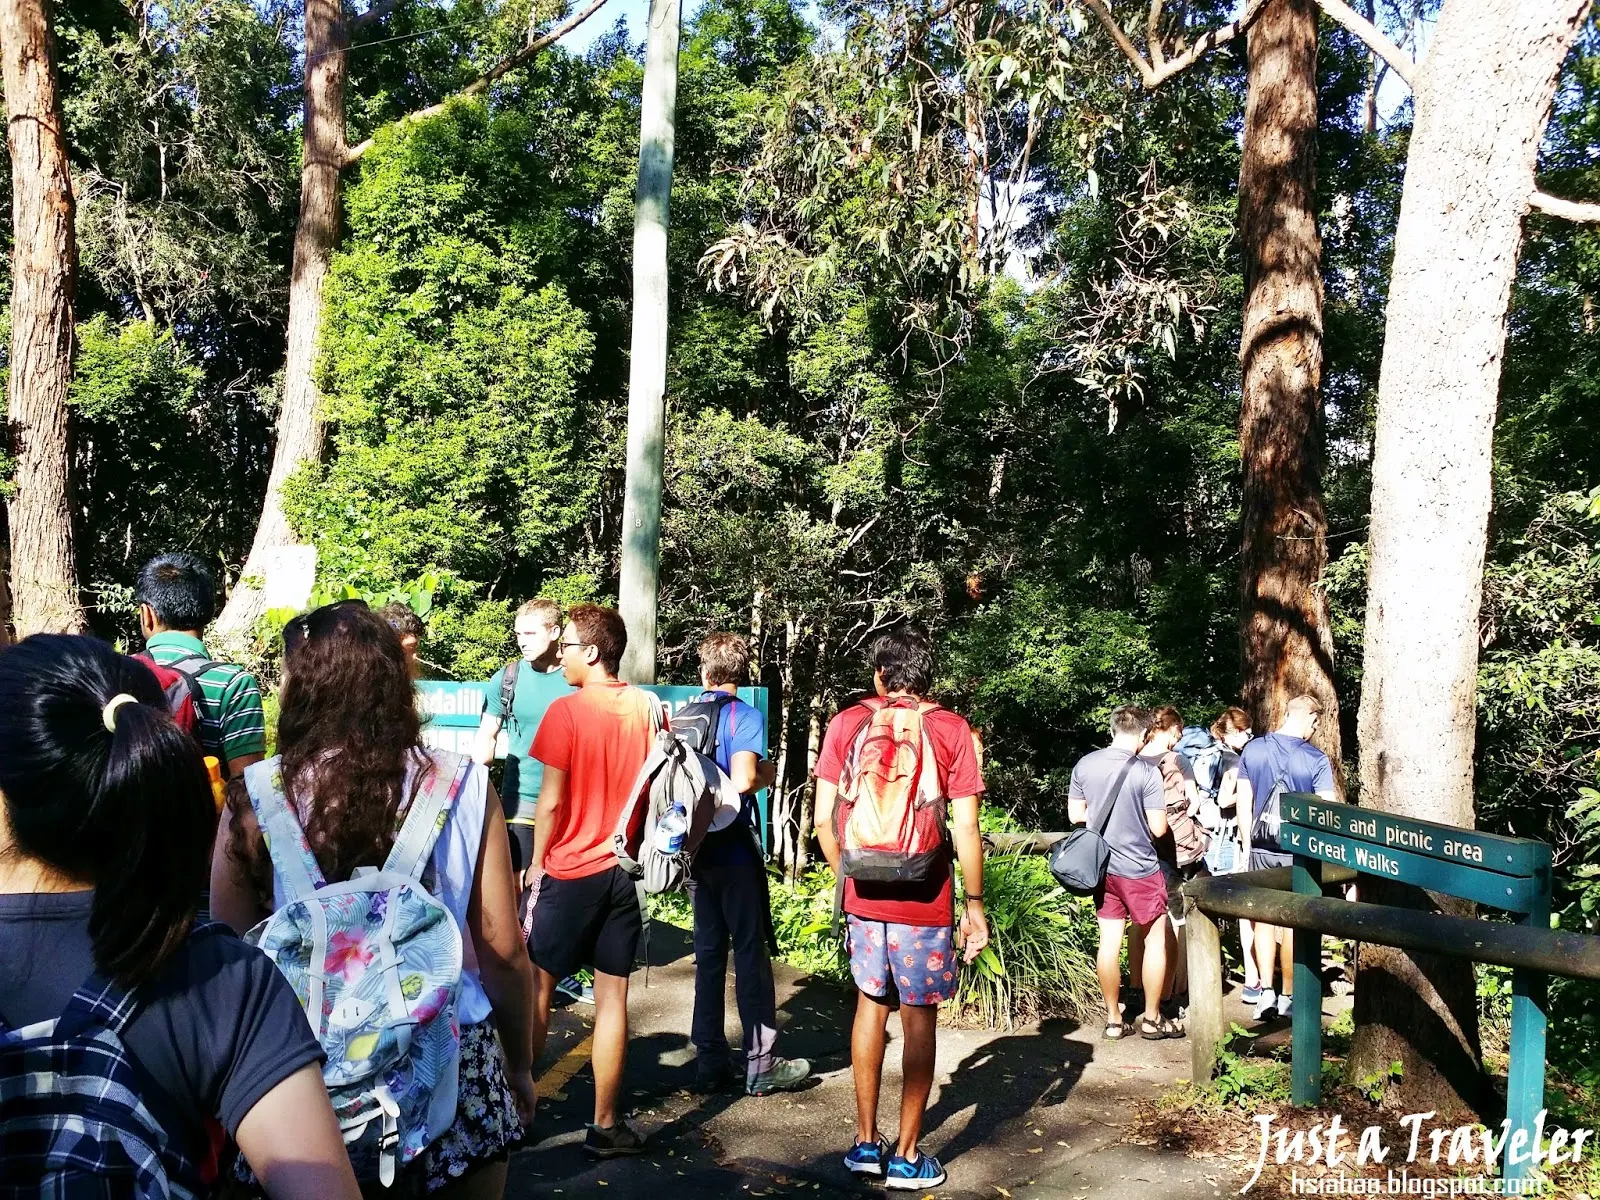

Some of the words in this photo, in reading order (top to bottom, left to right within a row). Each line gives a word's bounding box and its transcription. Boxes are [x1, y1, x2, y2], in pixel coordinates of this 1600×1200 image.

[1308, 806, 1341, 829] Falls
[1349, 818, 1377, 838] and
[1385, 825, 1433, 852] picnic
[1443, 838, 1483, 863] area
[1308, 835, 1346, 861] Great
[1355, 847, 1399, 876] Walks
